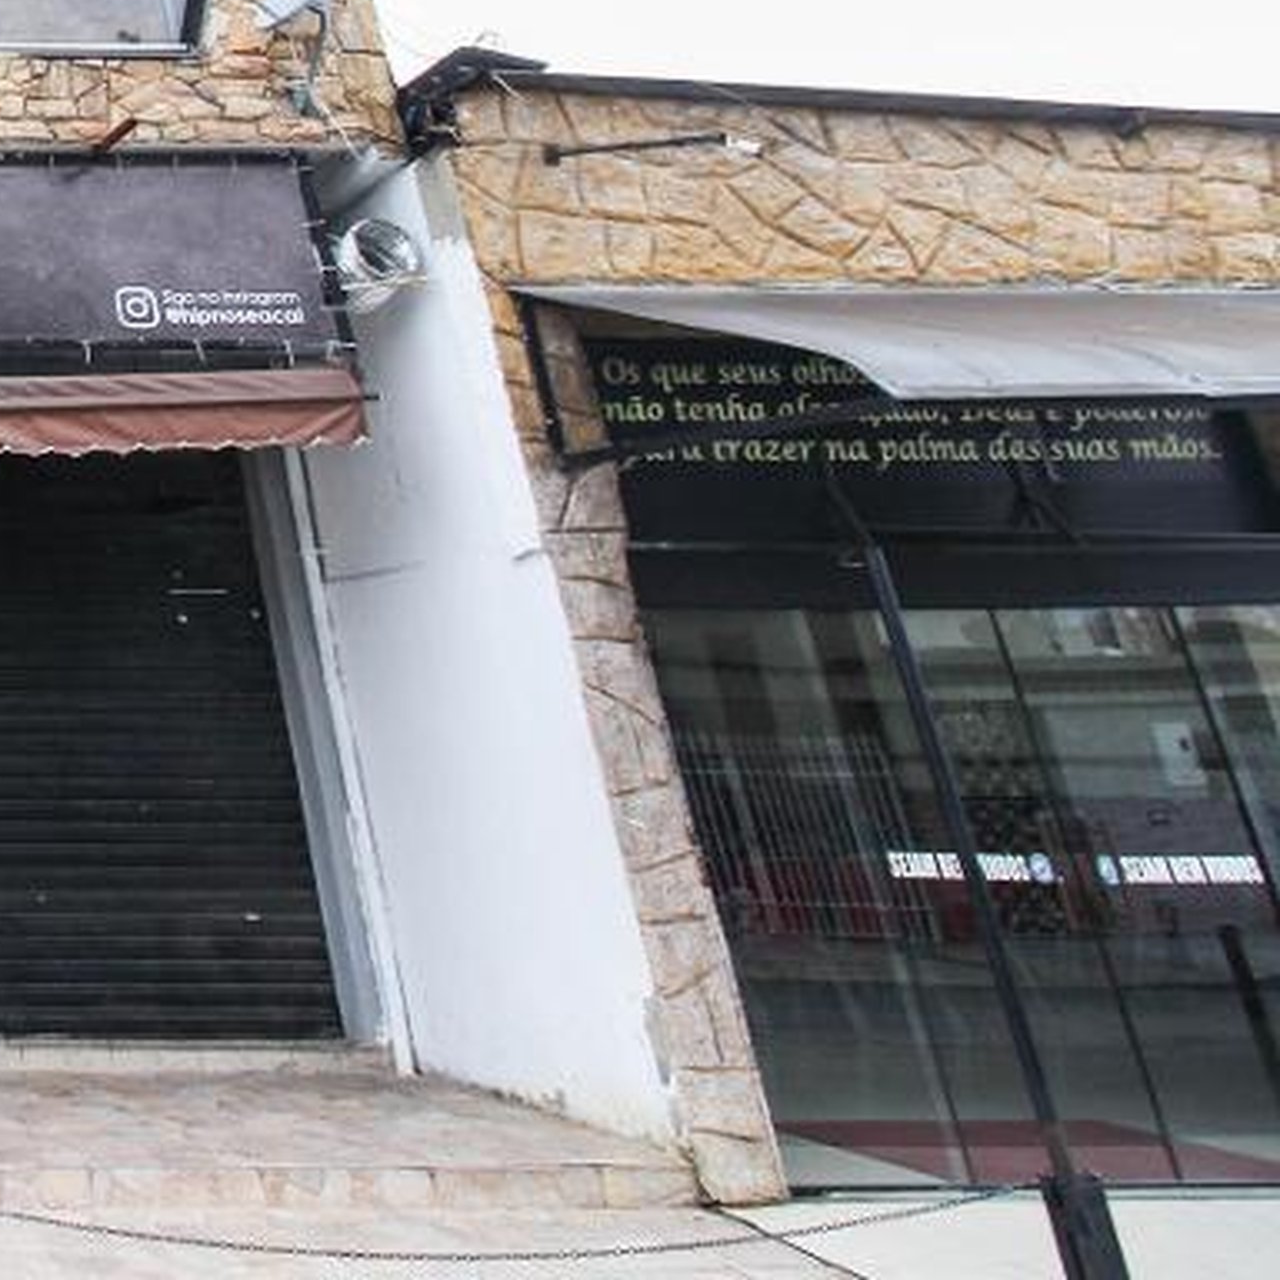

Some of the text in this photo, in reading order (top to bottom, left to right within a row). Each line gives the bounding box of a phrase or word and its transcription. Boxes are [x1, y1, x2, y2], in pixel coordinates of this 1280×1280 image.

[602, 357, 639, 385] Os
[652, 362, 707, 392] que
[718, 362, 782, 385] seus
[602, 395, 665, 421] não
[674, 393, 767, 421] tenha
[712, 434, 818, 463] trazer
[826, 438, 868, 462] na
[878, 432, 979, 470] palma
[1050, 437, 1120, 462] suas
